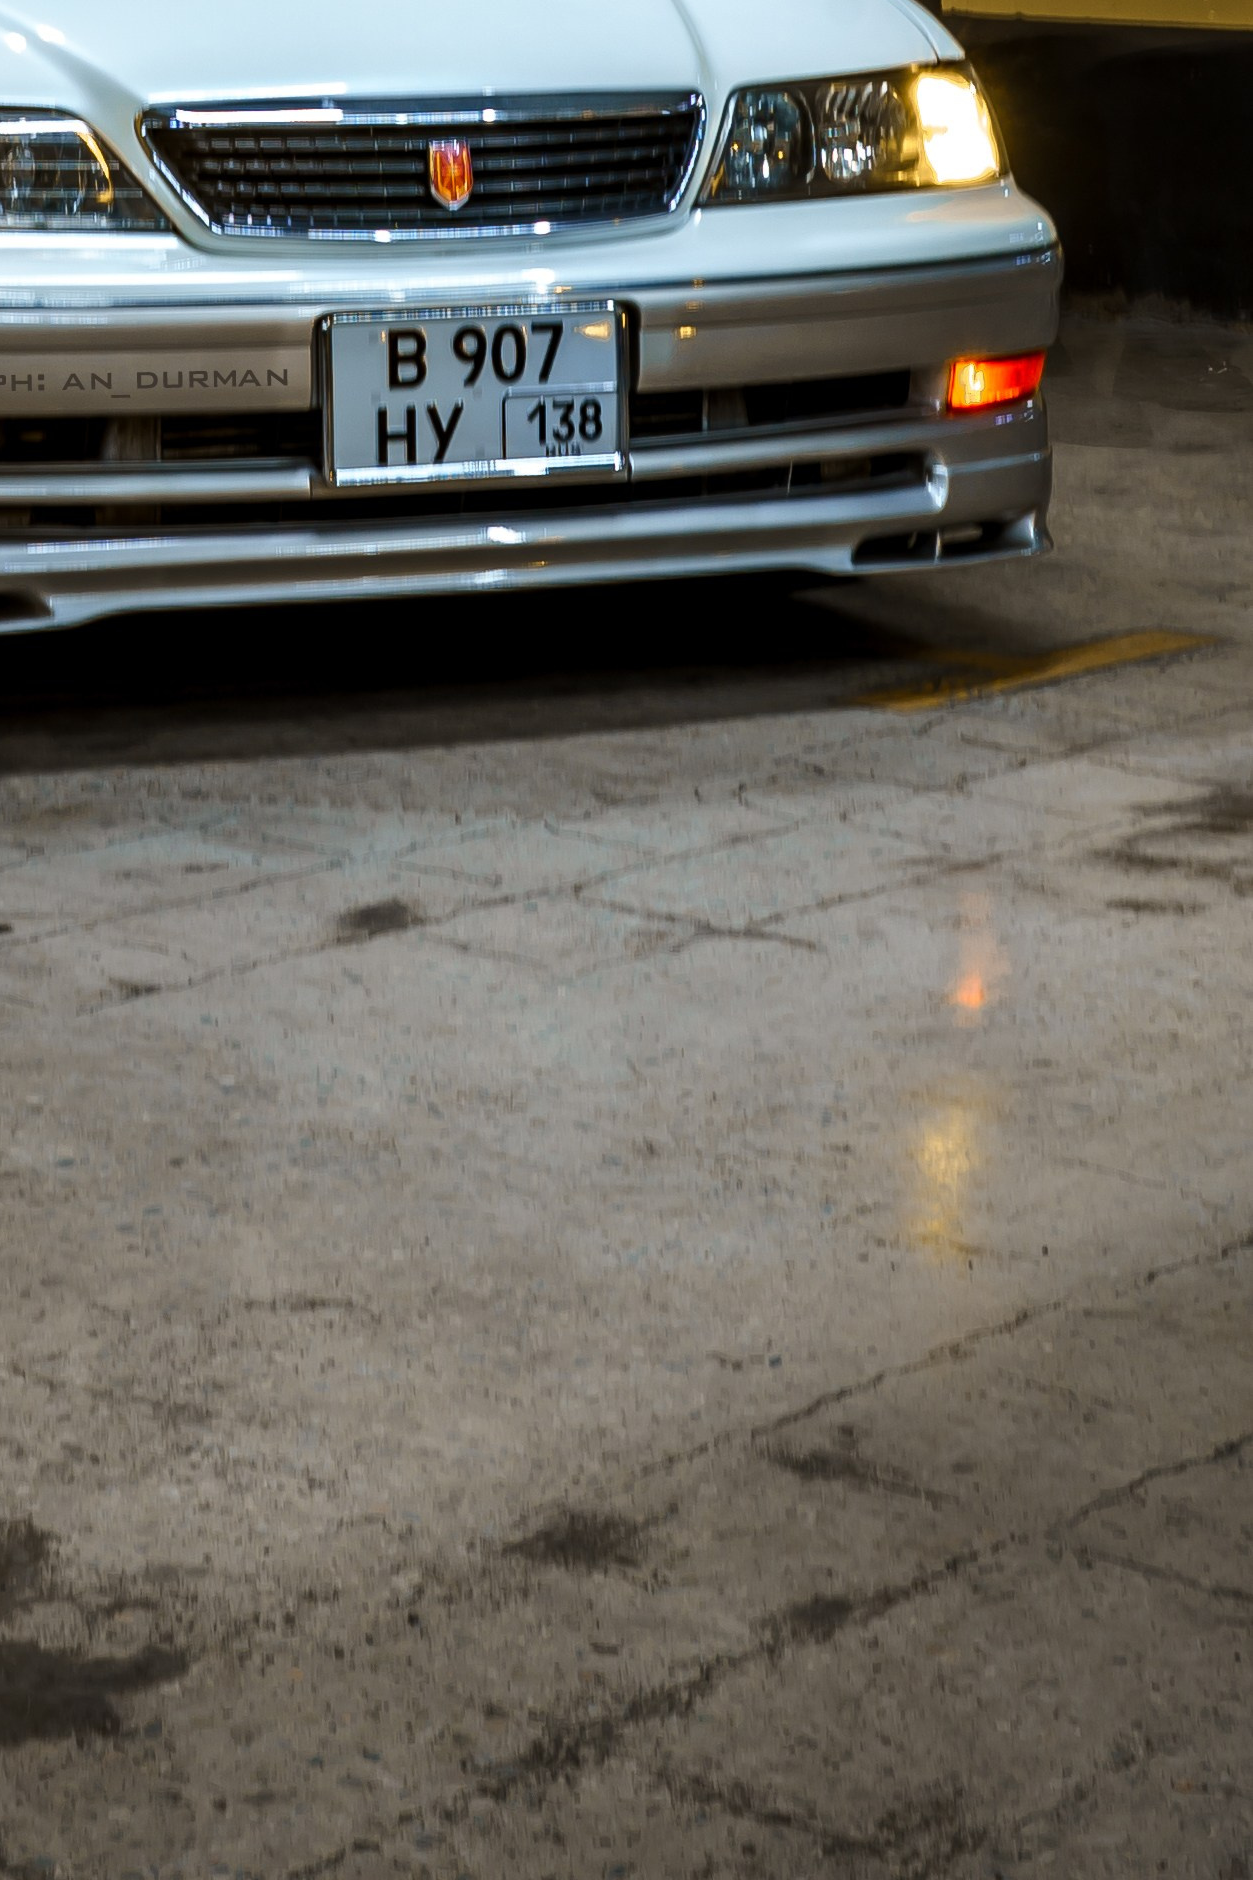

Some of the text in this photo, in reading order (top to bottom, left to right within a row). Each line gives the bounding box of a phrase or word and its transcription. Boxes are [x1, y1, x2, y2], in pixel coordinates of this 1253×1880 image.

[387, 320, 564, 391] В 907
[527, 395, 603, 446] 138
